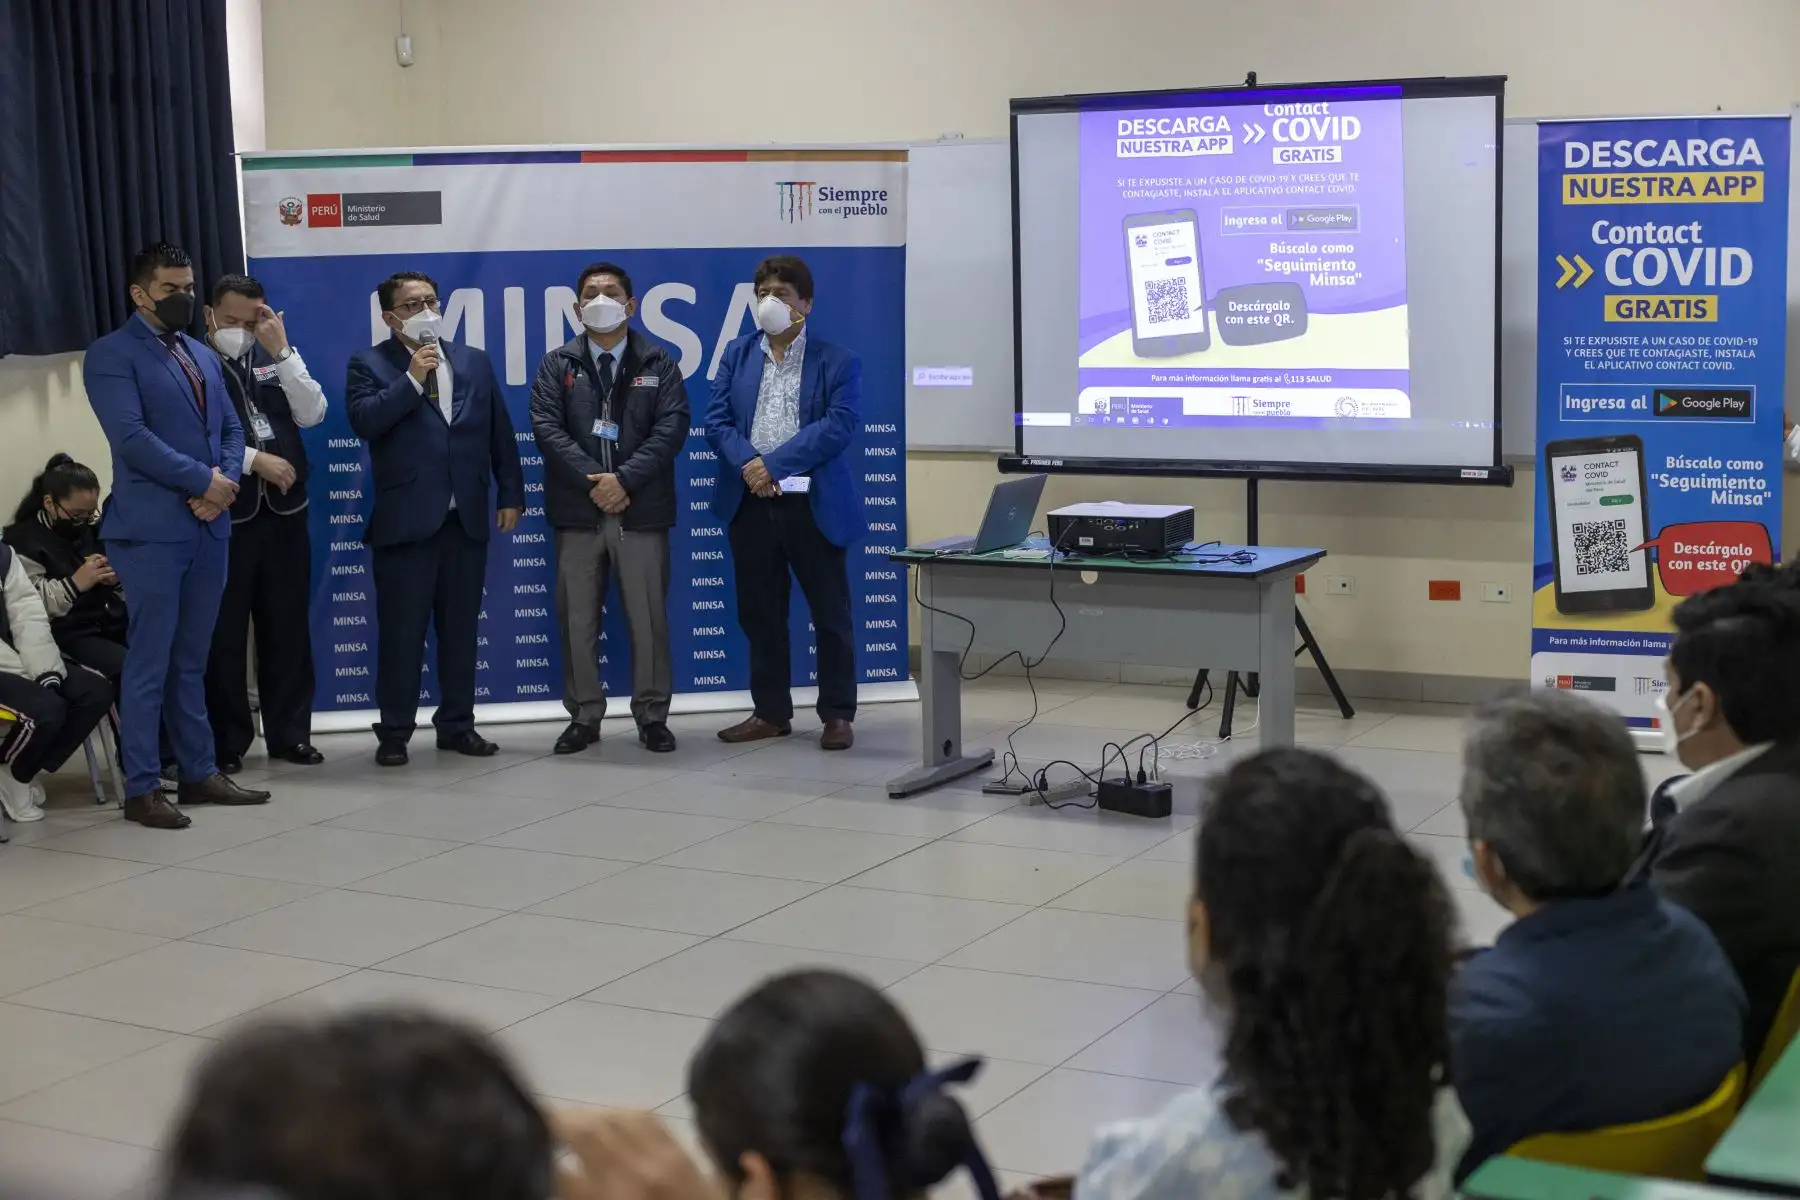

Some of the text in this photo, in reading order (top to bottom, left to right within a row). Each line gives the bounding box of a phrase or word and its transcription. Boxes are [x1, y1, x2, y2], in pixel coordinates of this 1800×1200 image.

[1117, 115, 1231, 136] DESCARGA
[1272, 115, 1362, 142] COVID
[1120, 137, 1228, 154] NUESTRA APP
[1279, 148, 1335, 162] GRATIS
[1564, 138, 1764, 168] DESCARGA
[1139, 177, 1183, 187] EXPUSISTE
[1185, 178, 1192, 186] A
[1194, 177, 1207, 186] UN
[1209, 175, 1233, 185] CASO
[1235, 175, 1247, 184] DE
[1249, 174, 1288, 184] COVID-19
[1290, 174, 1297, 182] Y
[1298, 173, 1325, 182] CREES
[1327, 173, 1346, 183] QUE
[1349, 172, 1360, 182] TE
[1183, 188, 1219, 197] INSTALA
[1221, 187, 1232, 196] EL
[1234, 186, 1284, 195] APLICATIVO
[1285, 185, 1325, 195] CONTACT
[1569, 176, 1757, 198] NUESTRA APP
[818, 186, 888, 206] Siempre
[311, 204, 338, 216] PERÚ
[347, 205, 386, 213] Ministerio
[834, 206, 842, 214] el
[843, 203, 888, 219] pueblo
[359, 213, 380, 221] Salud
[1224, 213, 1283, 228] Ingresa al
[1306, 214, 1352, 224] Google Play
[1591, 220, 1703, 244] Contact
[1269, 240, 1355, 254] Búscalo como
[1257, 258, 1357, 275] "Seguimiento
[1604, 247, 1754, 287] COVID
[1309, 272, 1362, 287] Minsa"
[1228, 299, 1291, 314] Descárgalo
[1615, 299, 1708, 319] GRATIS
[1224, 313, 1295, 327] con este QR.
[1563, 337, 1759, 346] SI TE EXPUSISTE A UN CASO DE COVID-19
[1565, 349, 1756, 359] Y CREES QUE TE CONTAGIASTE, INSTALA
[1584, 361, 1735, 370] EL APLICATIVO CONTACT COVID.
[1151, 374, 1332, 384] Para más información llama gratis al 113 SALUD
[1252, 399, 1291, 410] Siempre
[1565, 395, 1647, 412] Ingresa al
[1682, 397, 1745, 412] Google Play
[865, 424, 897, 433] MINSA
[328, 438, 361, 448] MINSA
[689, 451, 718, 461] MINS
[864, 447, 897, 456] MINSA
[520, 456, 545, 466] INSA
[1584, 461, 1619, 470] CONTACT
[1666, 454, 1764, 470] Búscalo como
[329, 462, 362, 473] MINSA
[690, 477, 716, 487] MINS
[864, 473, 897, 482] MINSA
[1651, 473, 1766, 492] "Seguimiento
[524, 483, 545, 493] NSA
[330, 490, 362, 499] MINSA
[1711, 490, 1771, 506] Minsa"
[865, 496, 897, 506] MINSA
[522, 506, 546, 517] NSA
[330, 514, 363, 524] MINSA
[691, 527, 723, 537] MINSA
[512, 534, 545, 544] MINSA
[331, 542, 364, 551] MINSA
[864, 545, 897, 555] MINSA
[1674, 541, 1753, 559] Descárgalo
[691, 551, 724, 560] MINSA
[513, 558, 546, 567] MINSA
[1668, 560, 1693, 570] con
[1697, 560, 1727, 571] este
[331, 565, 365, 575] MINSA
[865, 571, 897, 580] MINSA
[692, 577, 724, 587] MINSA
[514, 584, 547, 594] MINSA
[332, 592, 366, 601] MINSA
[865, 594, 897, 603] MINSA
[692, 600, 725, 610] MINSA
[514, 608, 548, 618] MINSA
[333, 616, 367, 626] MINSA
[865, 619, 897, 629] MINSA
[693, 626, 725, 636] MINSA
[515, 634, 548, 644] MINSA
[1549, 636, 1568, 645] Para
[1570, 637, 1588, 646] más
[1589, 638, 1641, 648] información
[1642, 639, 1667, 649] llama
[334, 643, 368, 652] MINSA
[865, 642, 897, 652] MINSA
[693, 650, 726, 659] MINSA
[516, 658, 549, 668] MINSA
[335, 666, 369, 677] MINSA
[866, 668, 898, 677] MINSA
[694, 675, 726, 685] MINSA
[517, 684, 548, 694] MINSA
[336, 693, 368, 703] MINSA
